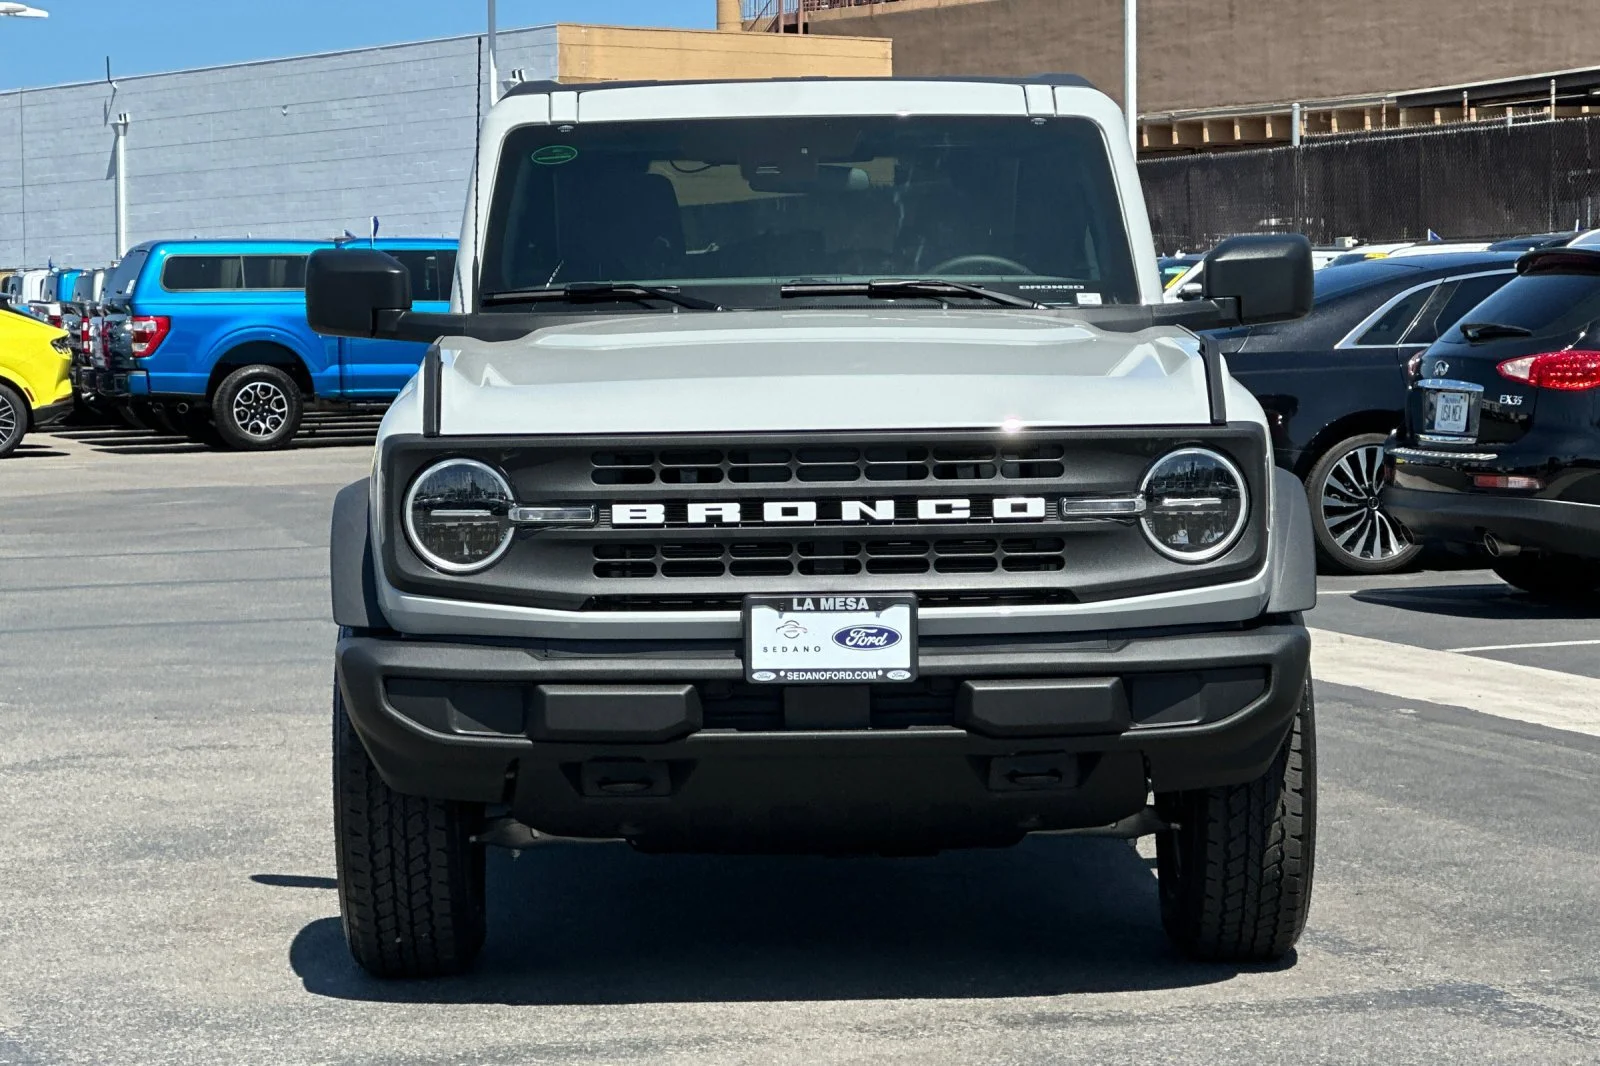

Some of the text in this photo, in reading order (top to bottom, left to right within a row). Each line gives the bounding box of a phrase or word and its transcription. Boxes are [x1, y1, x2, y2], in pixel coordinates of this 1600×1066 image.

[1499, 394, 1524, 405] EX35
[611, 496, 1046, 525] BRONCO
[792, 597, 870, 611] LA MESA
[845, 627, 888, 647] Ford
[762, 645, 822, 653] SEDANO
[787, 671, 877, 681] SEDANOFORD.COM
